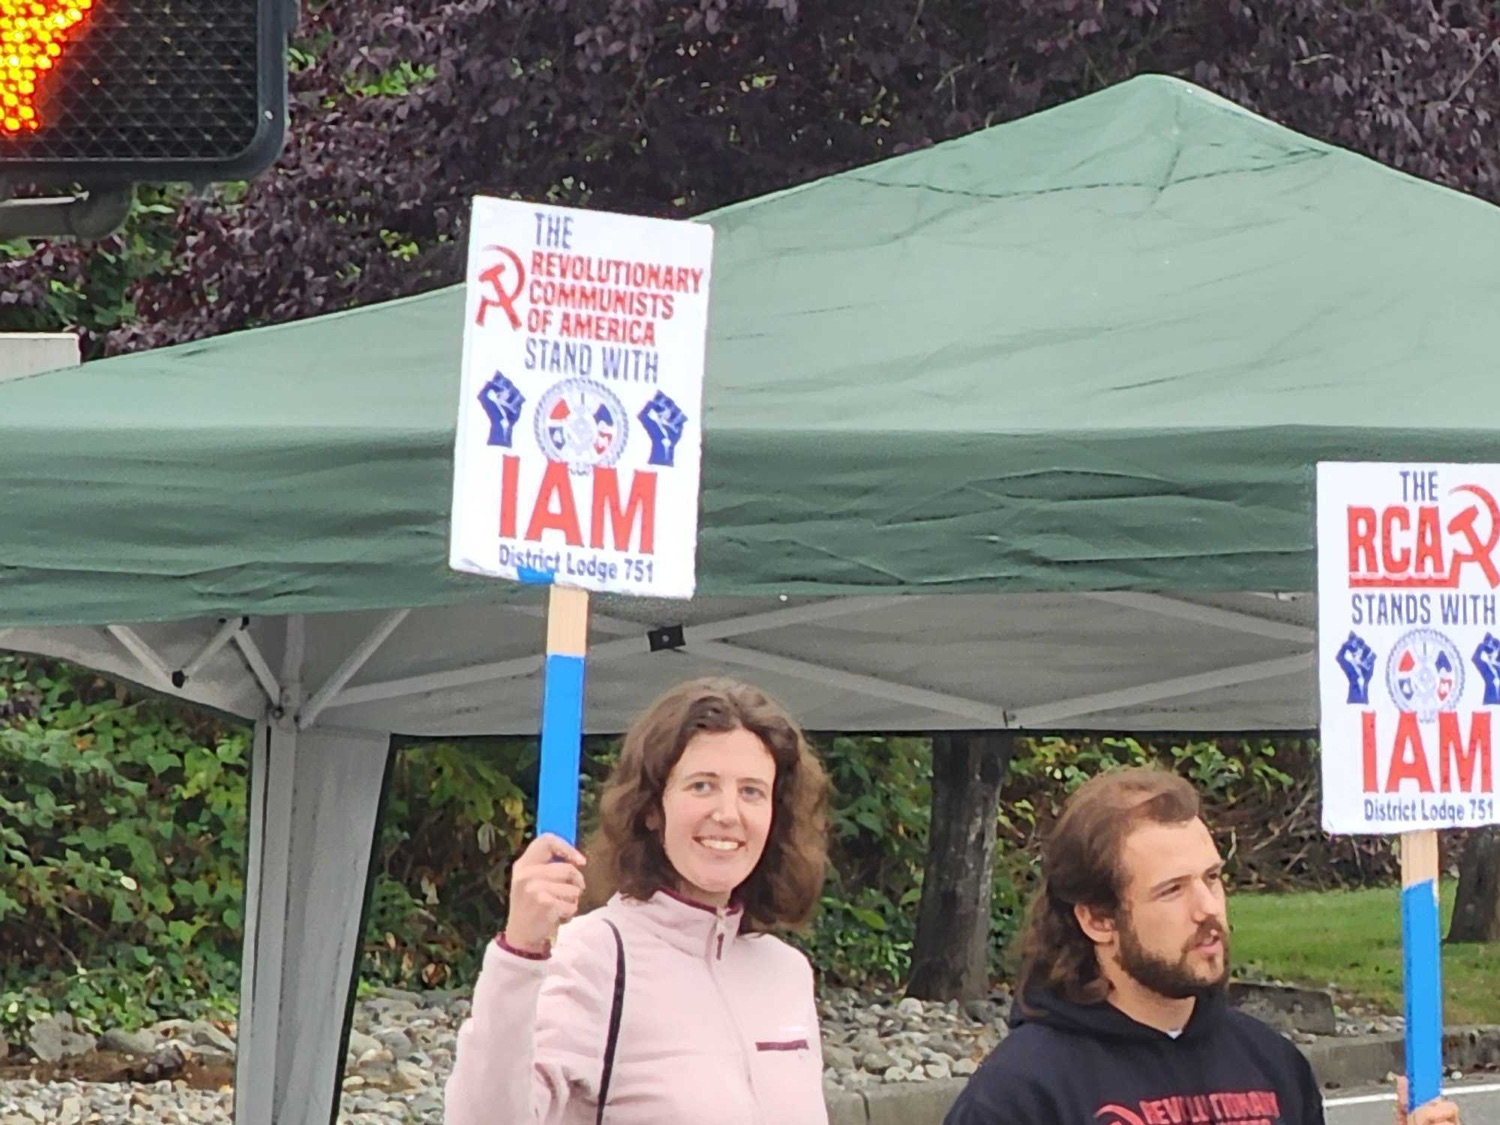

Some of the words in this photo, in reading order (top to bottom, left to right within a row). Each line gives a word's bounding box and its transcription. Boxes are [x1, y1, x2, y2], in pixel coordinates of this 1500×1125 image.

[534, 211, 574, 249] THE
[530, 250, 704, 294] REVOLUTIONARY
[529, 281, 675, 320] COMMUNISTS
[527, 309, 555, 335] OF
[558, 312, 656, 347] AMERICA
[525, 336, 592, 377] STAND
[601, 344, 659, 384] WITH
[498, 455, 658, 555] IAM
[1400, 471, 1439, 502] THE
[1347, 505, 1444, 574] RCA
[499, 544, 561, 573] District
[567, 549, 618, 583] Lodge
[624, 556, 654, 583] 751
[1351, 593, 1431, 626] STANDS
[1440, 594, 1496, 626] WITH
[1361, 711, 1494, 794] IAM
[1364, 798, 1416, 822] District
[1421, 798, 1465, 824] Lodge
[1469, 798, 1494, 821] 751
